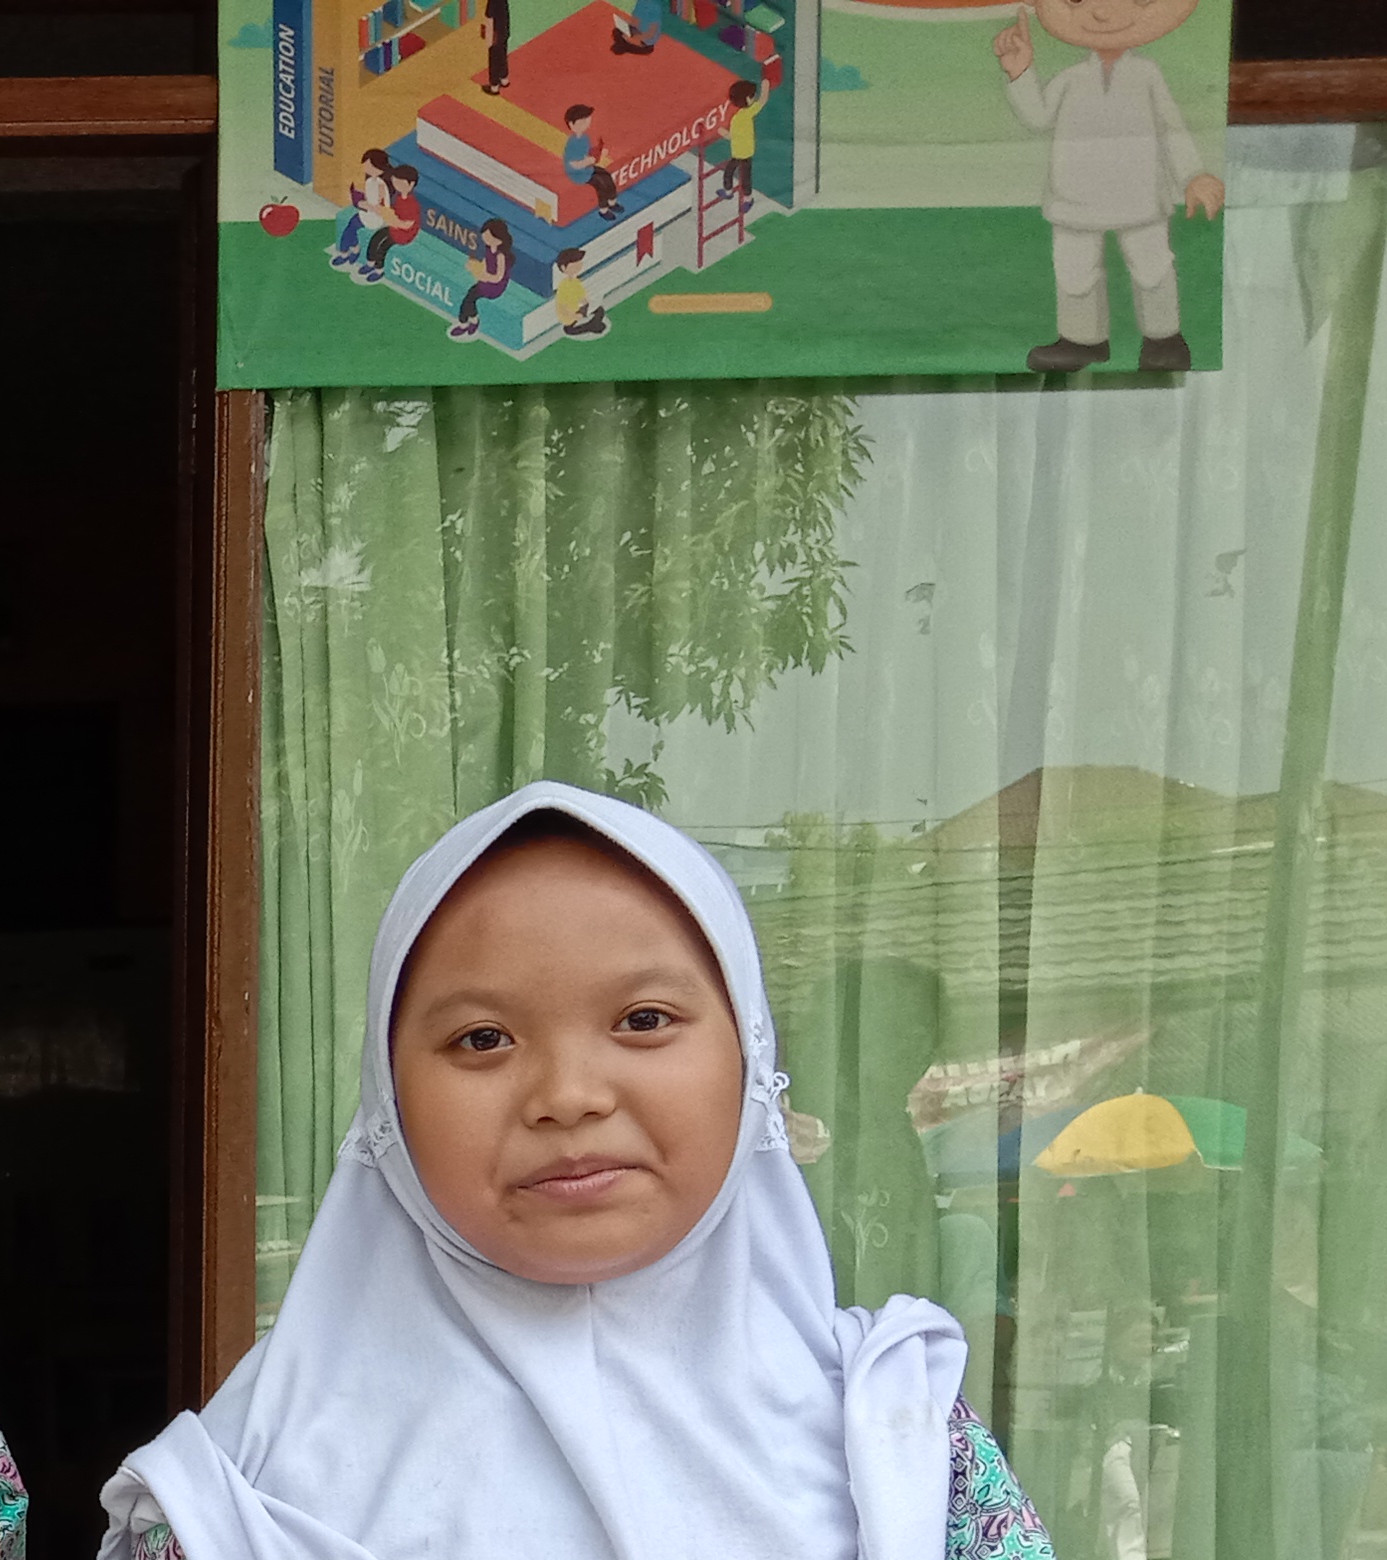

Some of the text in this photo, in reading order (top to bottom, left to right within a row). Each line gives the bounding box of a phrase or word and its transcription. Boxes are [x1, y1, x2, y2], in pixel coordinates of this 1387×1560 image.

[279, 23, 296, 140] EDUCATION
[319, 67, 335, 157] TUTORIAL
[426, 208, 478, 251] SAINS
[391, 257, 455, 306] SOCIAL
